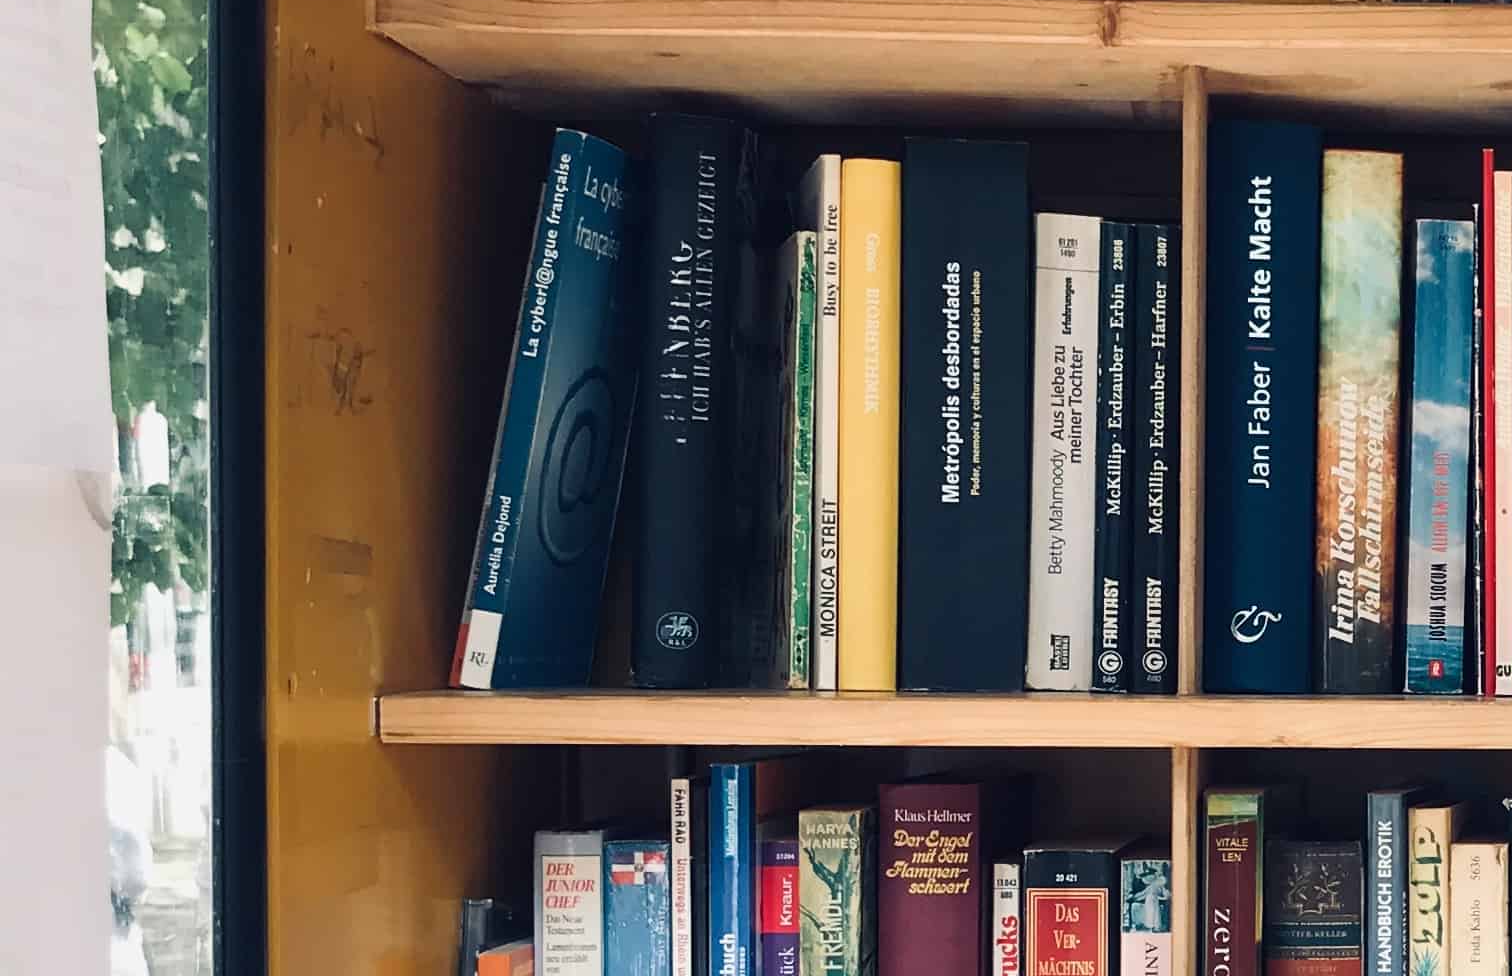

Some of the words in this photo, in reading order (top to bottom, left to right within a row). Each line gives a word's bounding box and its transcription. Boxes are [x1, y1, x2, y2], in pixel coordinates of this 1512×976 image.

[544, 154, 571, 225] française
[1249, 176, 1273, 260] Macht
[1113, 240, 1124, 272] 23806
[526, 229, 560, 334] cyberl@ngue
[970, 271, 982, 304] urbano
[1248, 269, 1272, 338] Kalte
[941, 261, 962, 390] desbordadas
[970, 307, 983, 343] espacio
[1109, 283, 1126, 328] Erbin
[523, 337, 539, 358] La
[970, 358, 981, 369] en
[1054, 345, 1066, 362] zu
[969, 372, 982, 408] culturas
[1050, 365, 1067, 408] Liebe
[1067, 347, 1085, 406] Tochter
[1107, 345, 1126, 430] Erdzauber
[1248, 362, 1272, 436] Faber
[941, 396, 962, 503] Metrópolis
[969, 422, 982, 464] memoria
[1049, 412, 1066, 440] Aus
[1067, 409, 1083, 465] meiner
[969, 467, 983, 496] Poder,
[1047, 449, 1067, 532] Mahmoody
[1106, 442, 1125, 516] McKillip
[1247, 445, 1272, 489] Jan
[491, 496, 512, 544] Dejond
[821, 498, 837, 559] STREIT
[482, 547, 504, 594] Aurélia
[1047, 536, 1067, 575] Betty
[820, 563, 837, 638] MONICA
[1103, 578, 1120, 648] FANTASY
[894, 809, 926, 823] Klaus
[928, 809, 972, 823] Hellmer
[547, 863, 574, 875] DER
[1379, 821, 1393, 886] EROTIK
[546, 880, 594, 893] JUNIOR
[546, 896, 582, 909] CHEF
[1377, 892, 1393, 975] HANDBUCH
